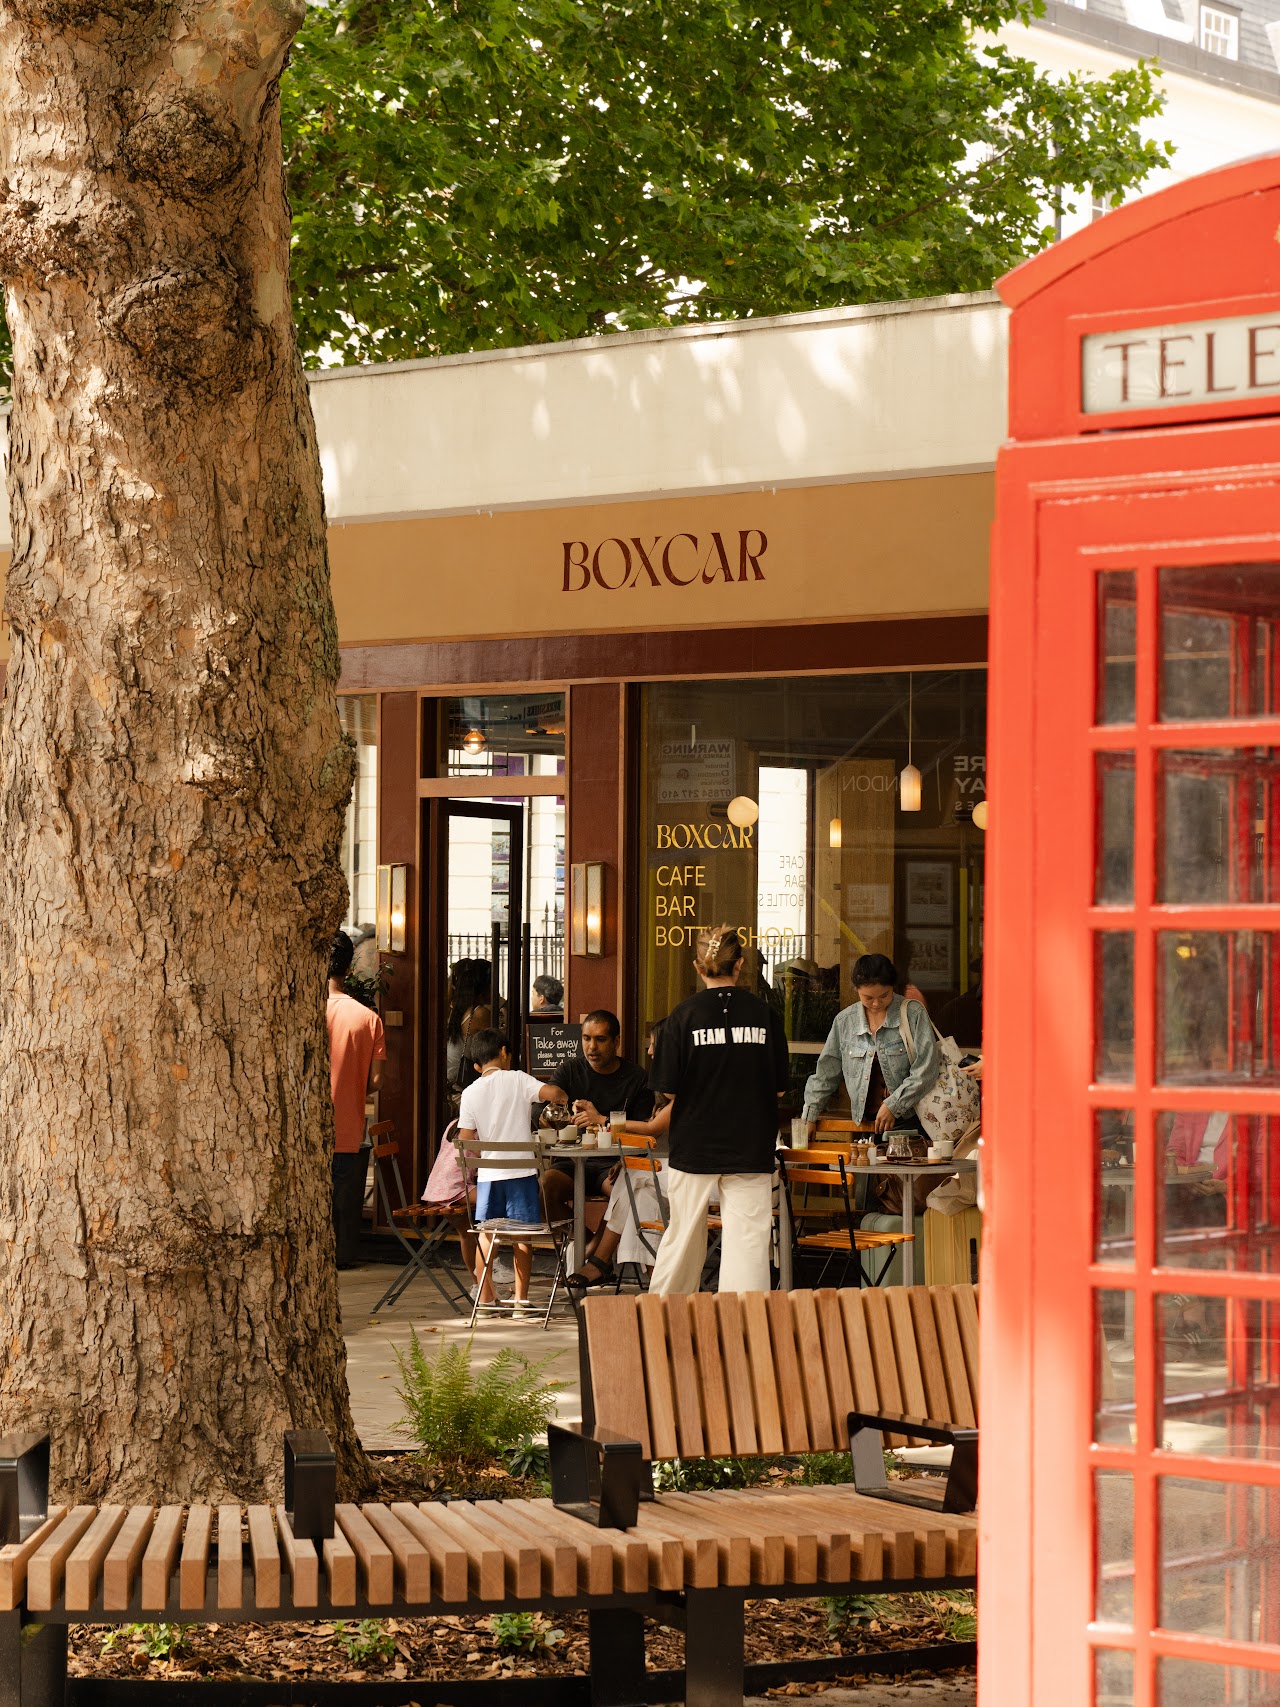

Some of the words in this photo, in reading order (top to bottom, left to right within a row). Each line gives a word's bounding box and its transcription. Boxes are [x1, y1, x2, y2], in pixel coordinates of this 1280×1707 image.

[562, 529, 768, 592] BOXCAR
[656, 823, 754, 849] BOXCAR
[656, 865, 706, 887] CAFE
[655, 895, 696, 917] BAR
[655, 926, 714, 947] BOTT
[737, 926, 796, 948] SHOP
[550, 1027, 565, 1037] For
[692, 1028, 727, 1047] TEAM
[731, 1026, 767, 1045] WANG
[532, 1036, 555, 1050] Take
[556, 1039, 579, 1052] away
[537, 1051, 554, 1060] please
[567, 1050, 577, 1059] the
[543, 1059, 558, 1067] other
